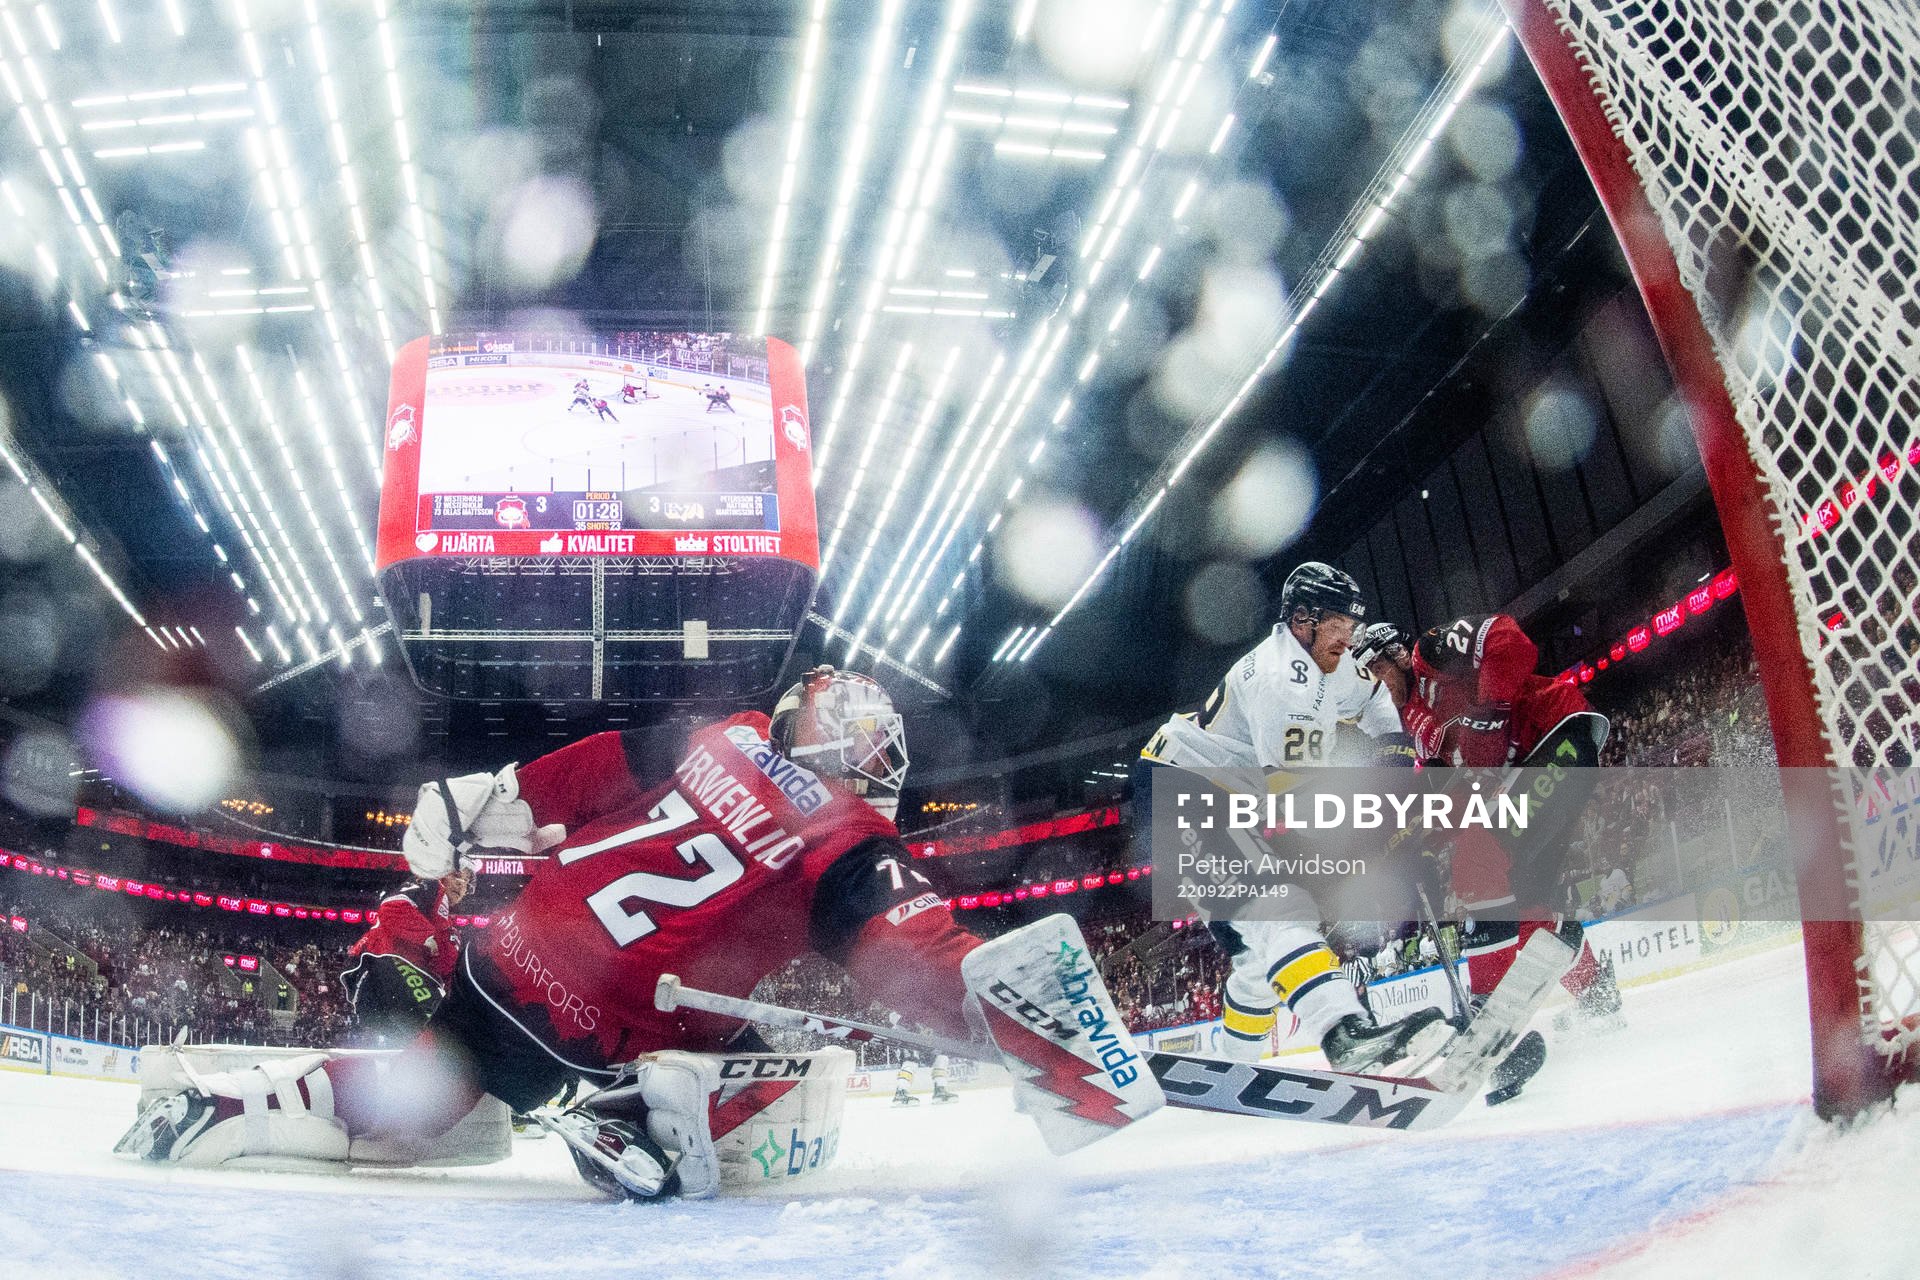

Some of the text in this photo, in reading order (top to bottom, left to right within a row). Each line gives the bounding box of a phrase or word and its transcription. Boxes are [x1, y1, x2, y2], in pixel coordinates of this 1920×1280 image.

[536, 496, 547, 513] 3
[585, 492, 617, 500] PERIOD 4
[650, 496, 660, 513] 3
[576, 503, 620, 519] 01:28
[575, 522, 621, 530] 35 SHOTS 23
[442, 533, 496, 552] HJÄRTA
[567, 535, 635, 552] KVALITET
[713, 535, 781, 553] STOLTHET
[1716, 574, 1734, 593] mix
[1689, 587, 1710, 607] mix
[1655, 604, 1680, 628] mix
[1447, 619, 1474, 654] 27
[1628, 628, 1647, 645] mix
[1462, 716, 1505, 731] CCM
[1284, 727, 1324, 761] 28
[486, 860, 524, 875] HJÄRTA
[557, 789, 745, 949] 72
[98, 875, 119, 887] mix
[126, 881, 144, 892] mix
[1055, 879, 1075, 890] mix
[1084, 876, 1101, 886] mix
[220, 897, 241, 909] mix
[250, 902, 268, 911] mix
[343, 911, 359, 920] mix
[1620, 924, 1694, 963] HOTEL
[501, 926, 601, 1031] BJURFORS
[1385, 979, 1429, 1008] Malmö
[987, 979, 1081, 1041] CCM
[1058, 968, 1138, 1089] bravida
[9, 1036, 41, 1061] RSA
[719, 1058, 812, 1079] CCM
[1149, 1052, 1434, 1131] CCM
